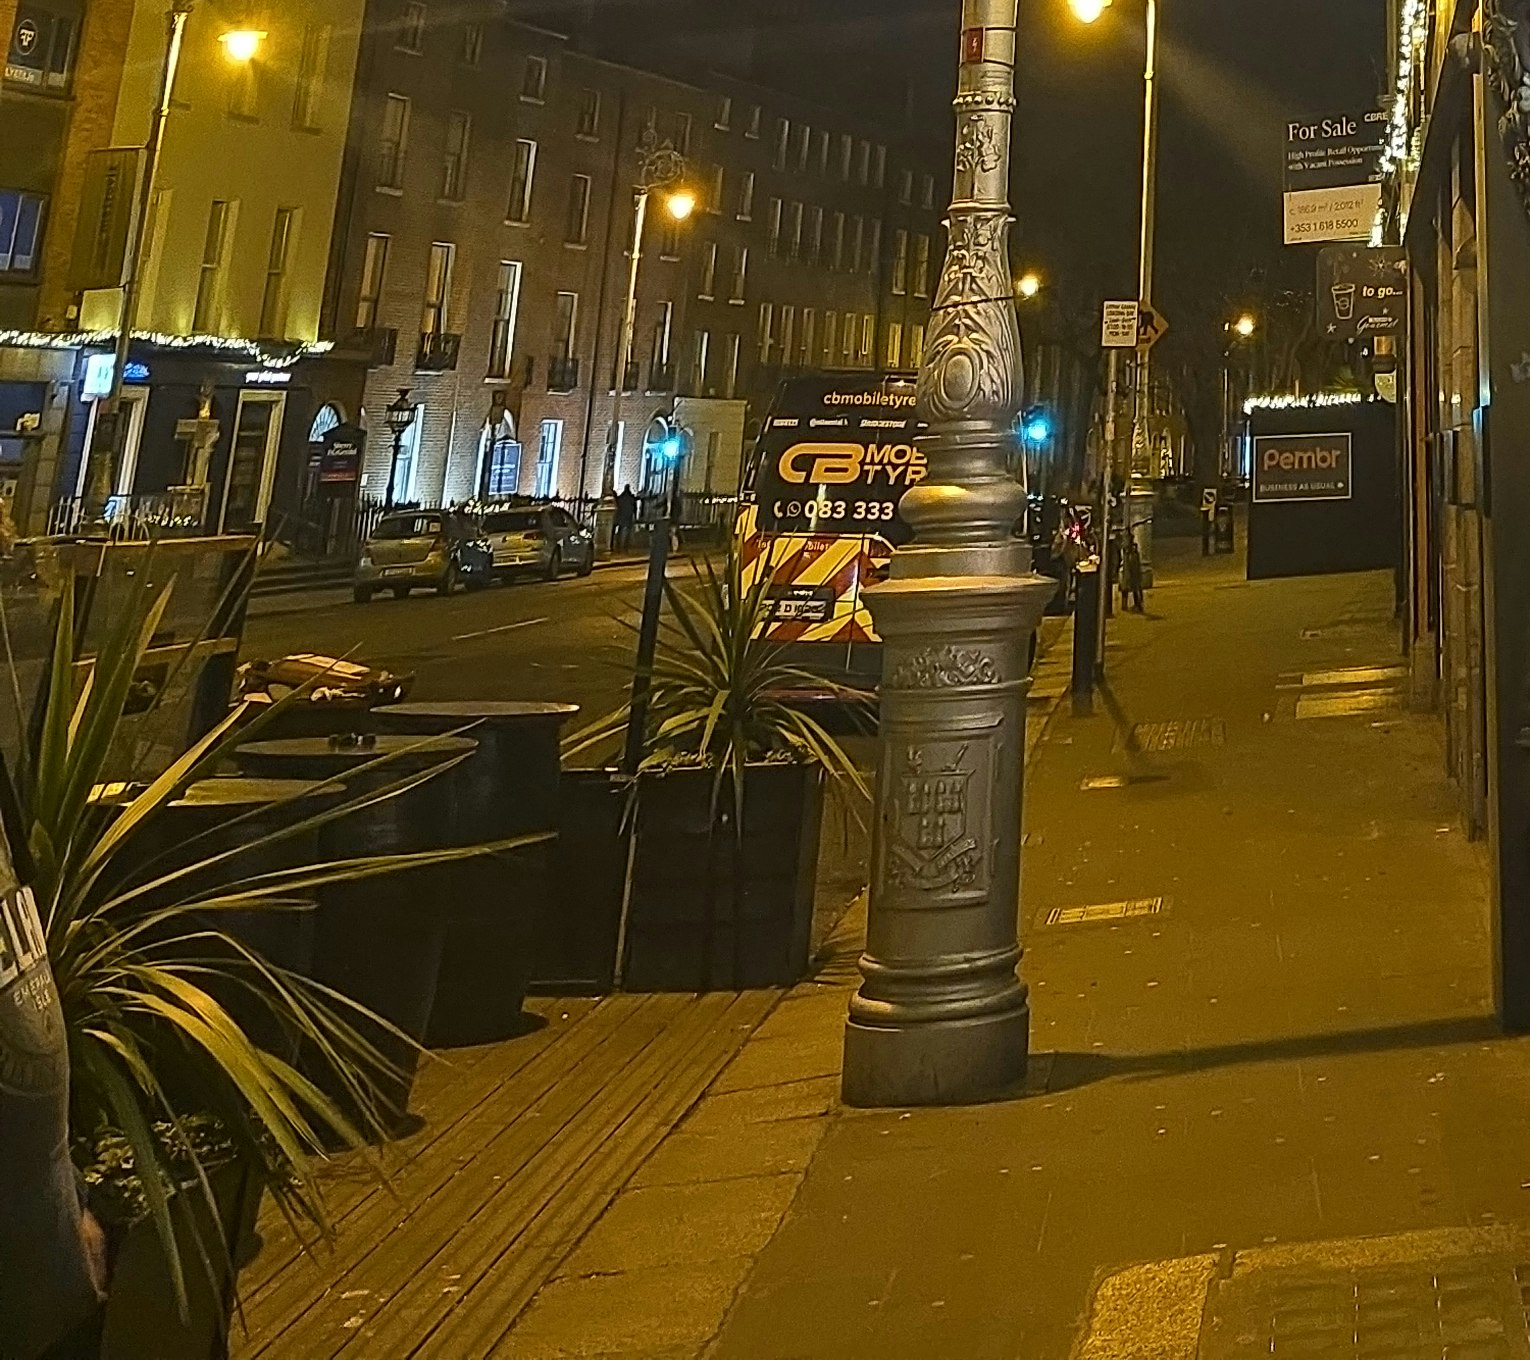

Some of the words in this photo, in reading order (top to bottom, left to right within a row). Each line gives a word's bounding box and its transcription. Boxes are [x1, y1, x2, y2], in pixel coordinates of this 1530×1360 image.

[1287, 121, 1318, 142] For
[1321, 116, 1358, 138] Sale
[1362, 285, 1375, 298] to
[778, 441, 866, 485] CB
[804, 500, 846, 520] 083
[852, 500, 895, 521] 333
